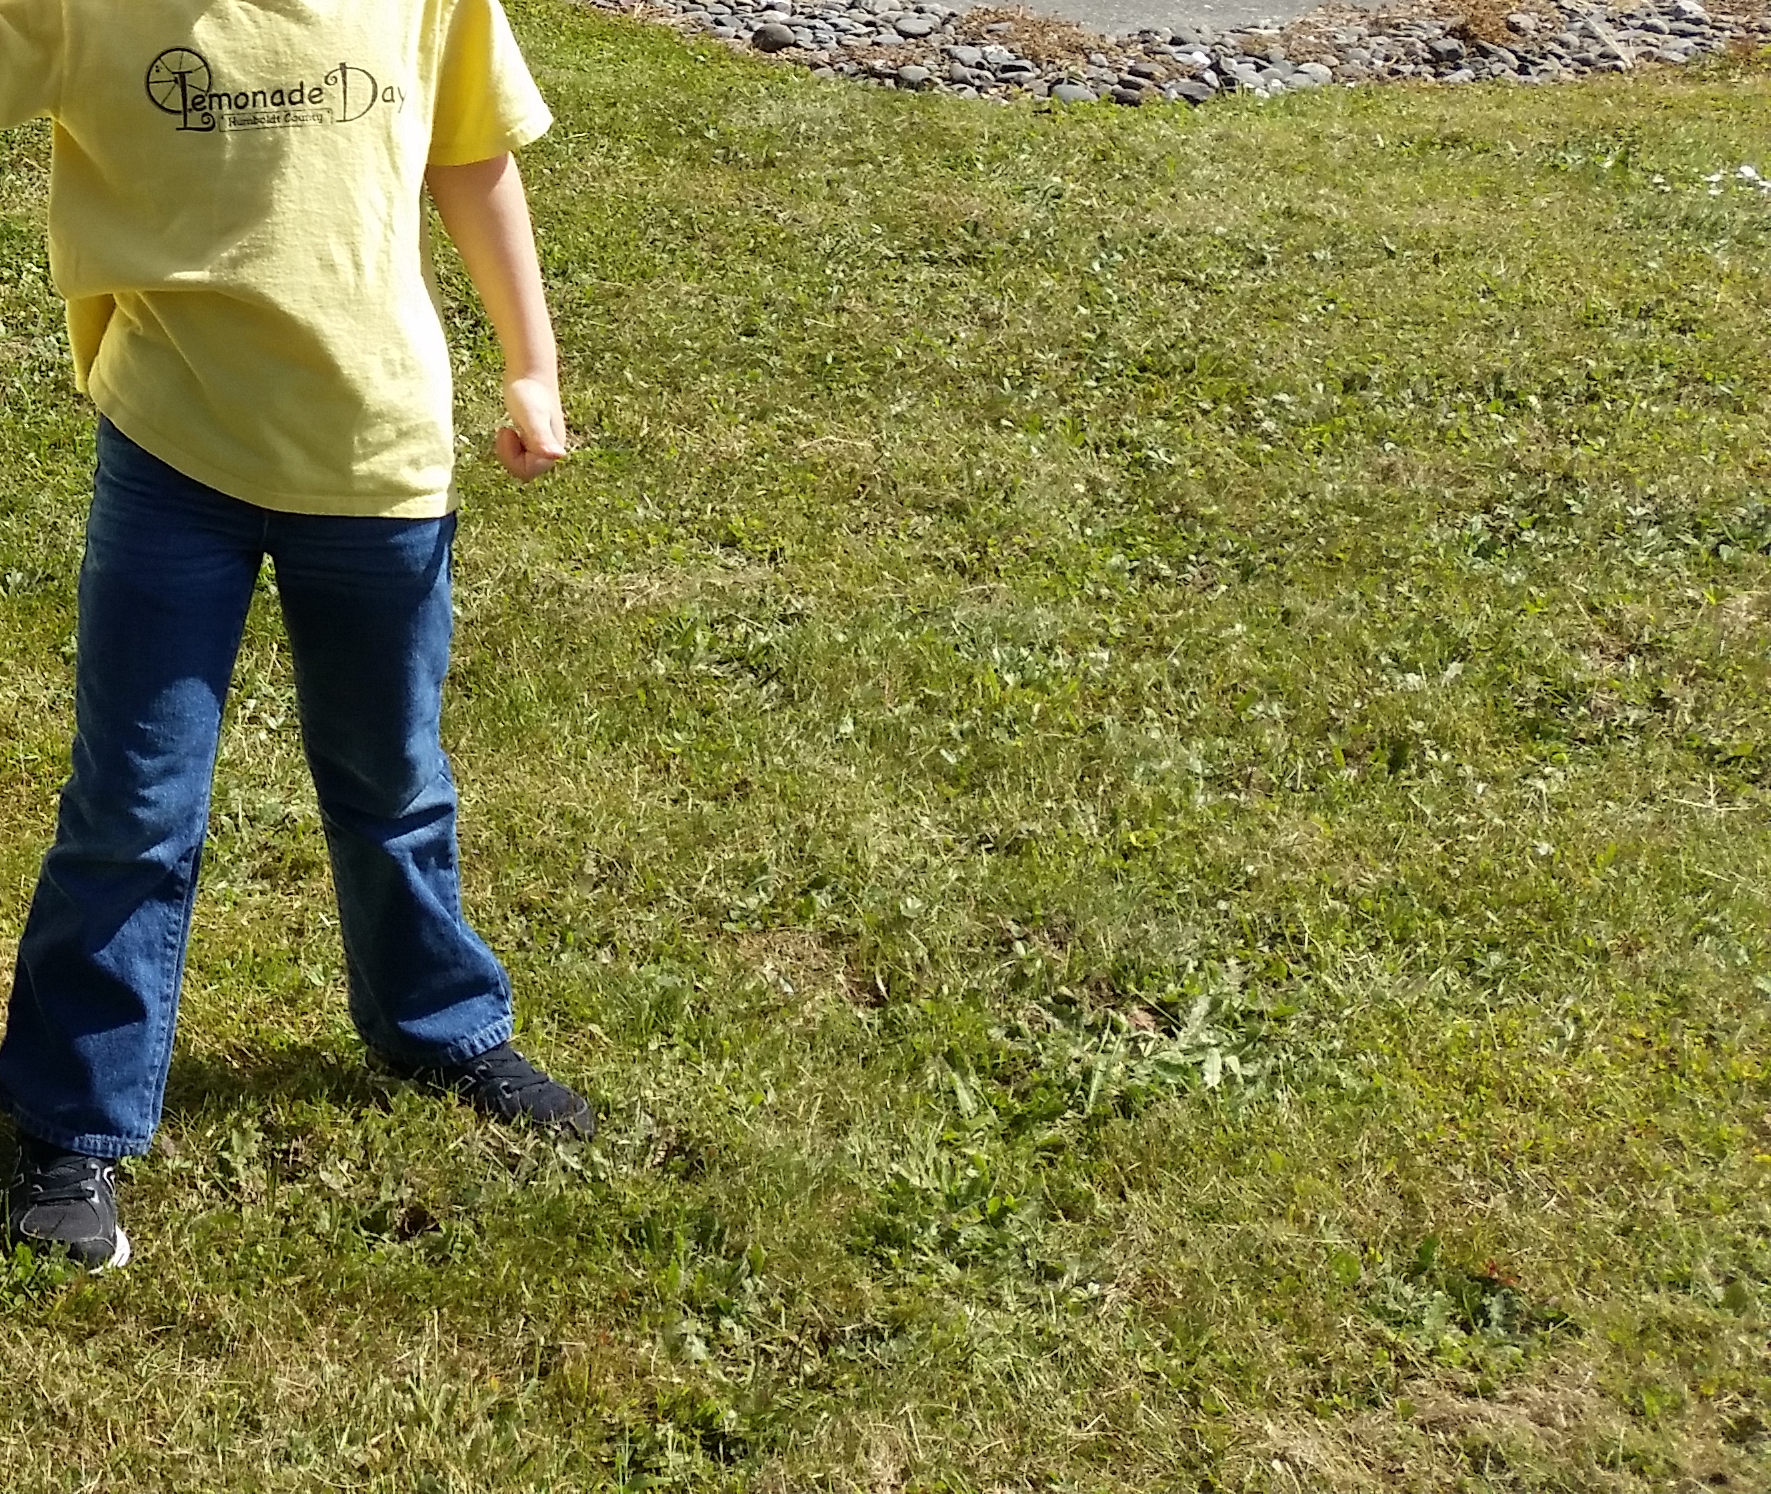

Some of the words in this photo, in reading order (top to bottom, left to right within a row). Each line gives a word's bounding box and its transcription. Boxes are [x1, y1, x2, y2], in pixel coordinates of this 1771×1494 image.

[175, 70, 325, 132] Lemonade
[323, 62, 407, 123] Day
[283, 112, 324, 124] County
